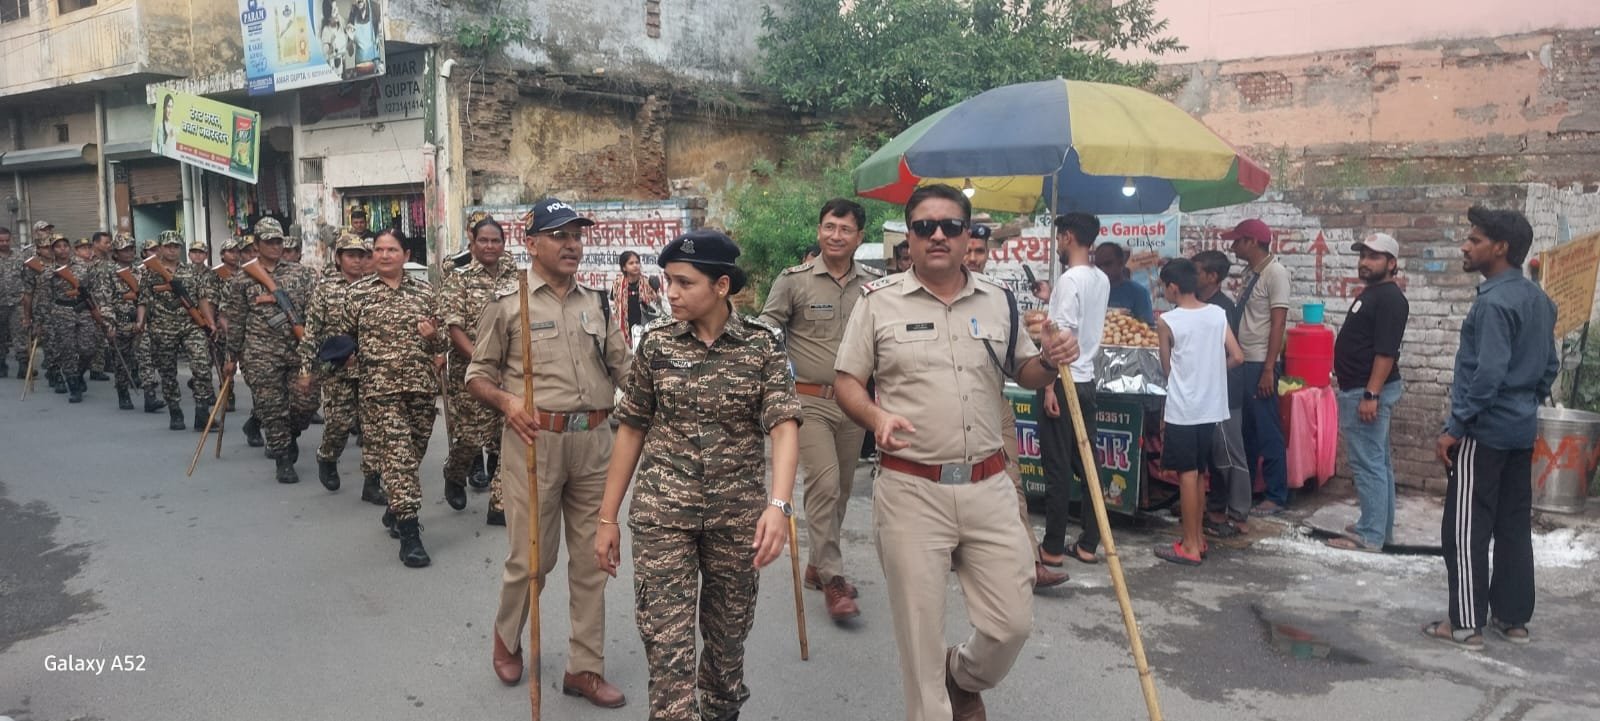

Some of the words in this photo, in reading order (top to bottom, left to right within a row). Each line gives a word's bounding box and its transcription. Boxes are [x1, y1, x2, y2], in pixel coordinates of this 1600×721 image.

[243, 9, 265, 24] PARAM
[385, 61, 416, 77] AMAR
[290, 72, 307, 82] GUPTA
[384, 81, 420, 97] GUPTA
[1112, 221, 1166, 236] Ganesh
[1126, 239, 1166, 248] Classes
